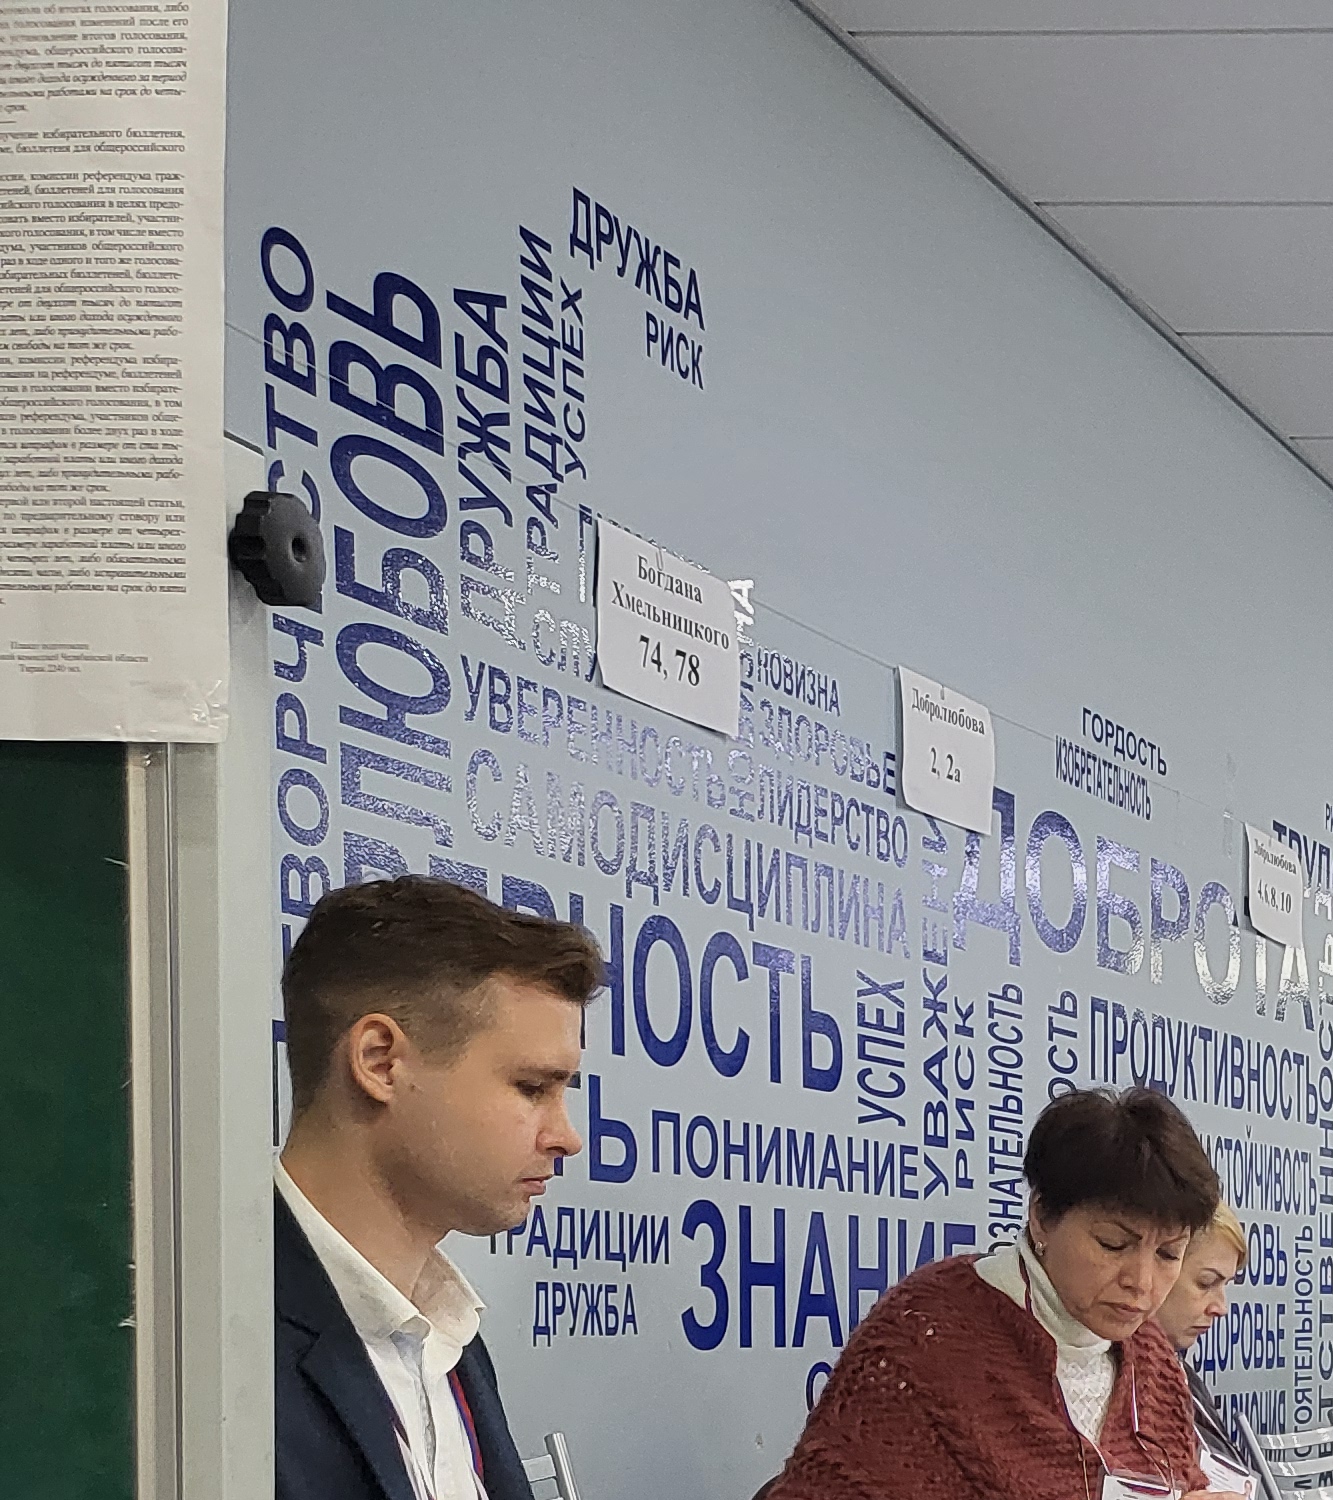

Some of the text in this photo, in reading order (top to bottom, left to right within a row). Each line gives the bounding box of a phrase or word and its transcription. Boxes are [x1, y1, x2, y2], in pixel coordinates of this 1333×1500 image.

[140, 18, 169, 26] после
[83, 171, 151, 183] референдума
[94, 142, 185, 154] общероссийского
[570, 186, 705, 331] ДРУЖБА
[559, 276, 587, 479] УСПЕХ
[645, 311, 705, 390] РИСК
[519, 225, 564, 596] ТРАДИЦИИ
[453, 288, 526, 652] ДРУЖБА
[325, 270, 452, 849] ЛЮБОВЬ
[637, 555, 703, 604] Богдана
[611, 580, 730, 650] Хмельницкого
[639, 635, 668, 680] 74,
[675, 649, 700, 686] 78
[757, 643, 841, 717] НОВИЗНА
[911, 687, 985, 735] Добролюбова
[460, 654, 726, 809] УВЕРЕННОСТЬ
[759, 697, 897, 797] ЗДОРОВЬЕ
[946, 753, 961, 783] 2а
[1082, 706, 1167, 776] ГОРДОСТЬ
[757, 763, 909, 868] ЛИДЕРСТВО
[1055, 734, 1152, 821] ИЗОБРЕТАТЕЛЬНОСТЬ
[465, 748, 911, 960] САМОДИСЦИПЛИНА
[857, 969, 906, 1127] УСПЕХ
[921, 815, 950, 1200] УВАЖЕНИ
[954, 996, 975, 1190] РИСК
[1089, 996, 1319, 1126] ПРОДУКТИВНОСТЬ
[651, 1109, 920, 1201] ПОНИМАНИЕ
[988, 983, 1024, 1256] ОЗНАТЕЛЬНОСТЬ
[1200, 1125, 1318, 1216] АСТОЙЧИВОСТЬ
[490, 1205, 670, 1272] АДИЦИИ
[680, 1200, 976, 1351] ЗНАН
[532, 1281, 638, 1347] ДРУЖБА
[1193, 1302, 1286, 1386] ЗДОРОВЬЕ
